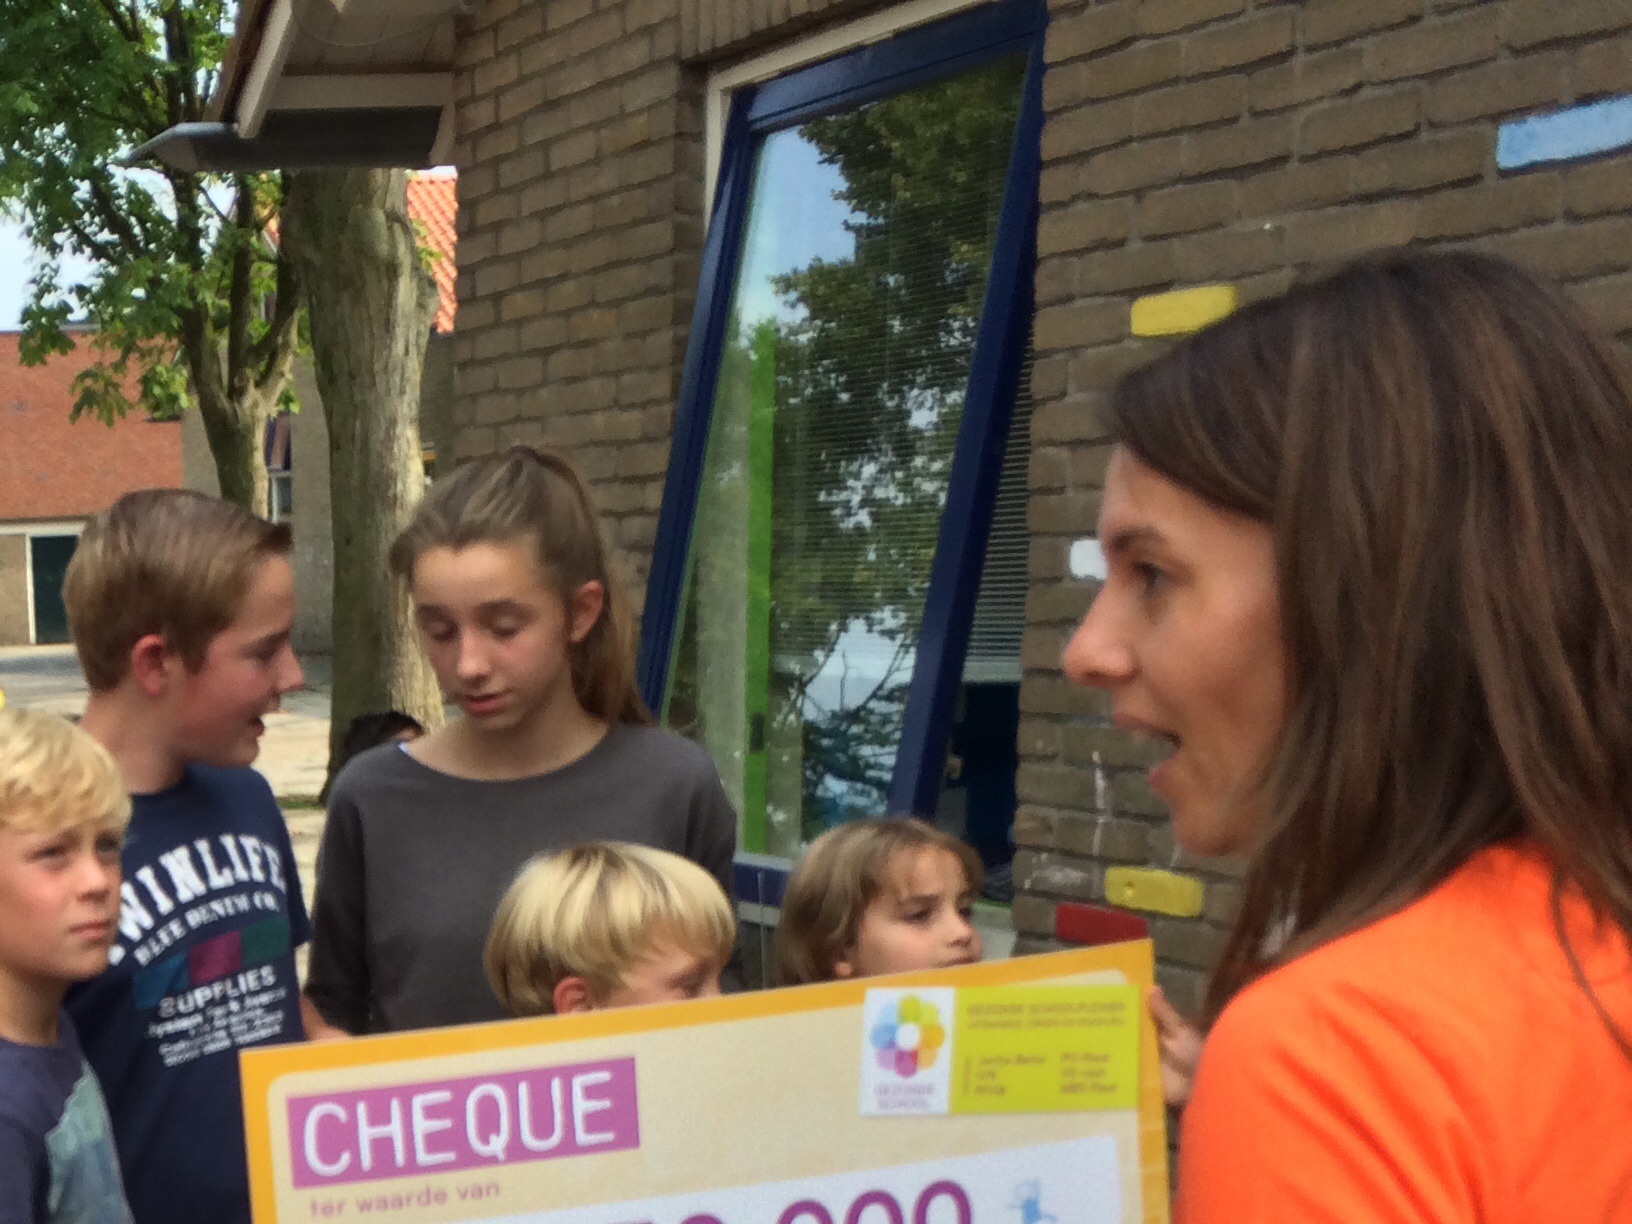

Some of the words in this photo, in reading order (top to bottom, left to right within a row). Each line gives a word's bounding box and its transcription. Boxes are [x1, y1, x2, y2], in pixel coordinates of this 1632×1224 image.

[157, 964, 277, 1019] SUPPLIES
[303, 1070, 616, 1178] CHEQUE
[309, 1199, 347, 1219] ter
[356, 1185, 448, 1214] waarde
[456, 1182, 501, 1201] van
